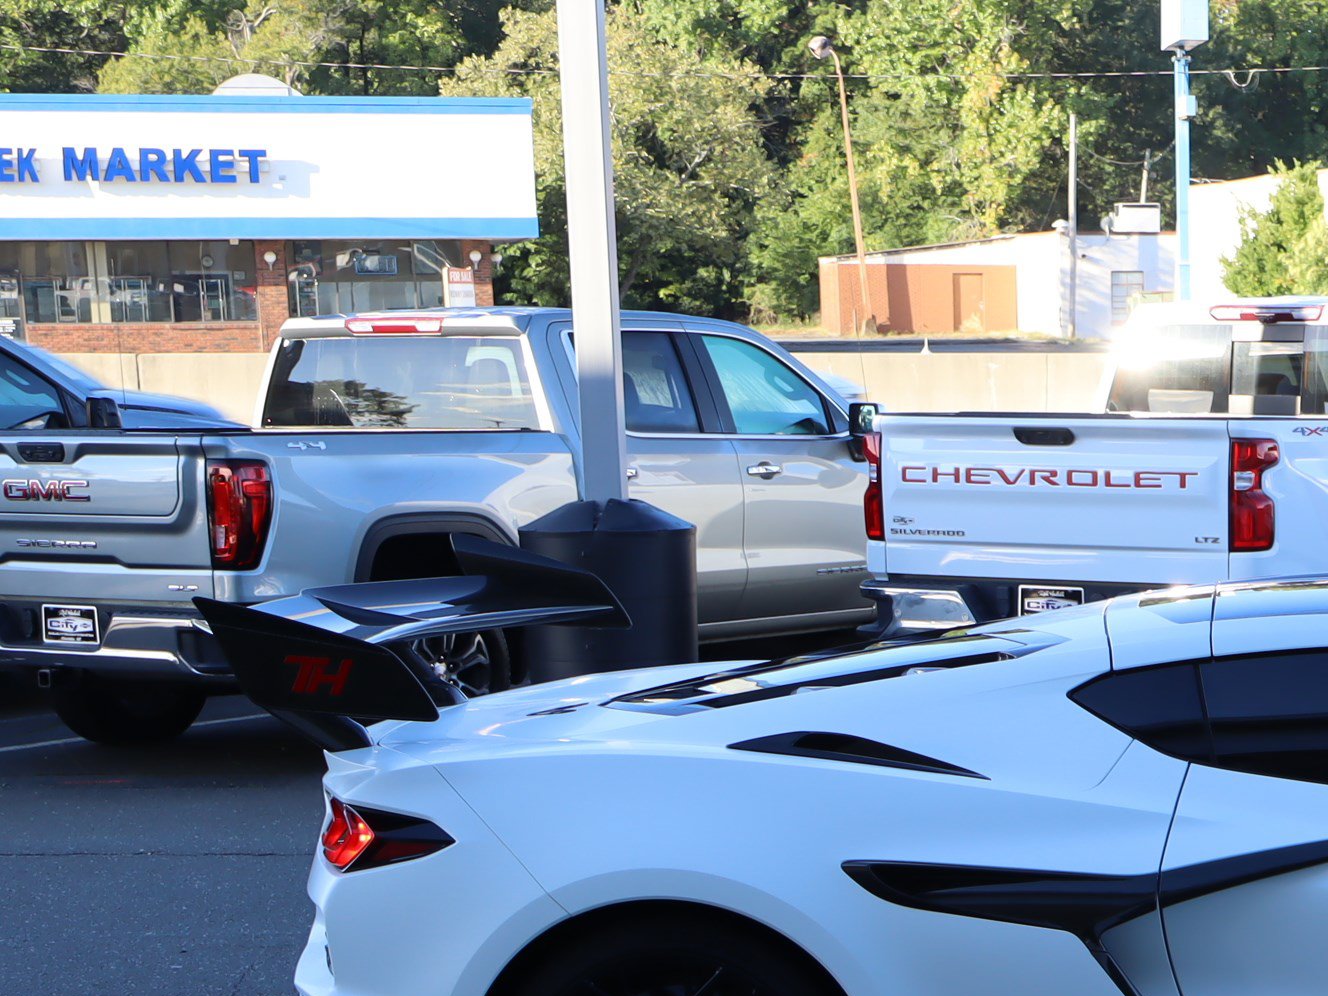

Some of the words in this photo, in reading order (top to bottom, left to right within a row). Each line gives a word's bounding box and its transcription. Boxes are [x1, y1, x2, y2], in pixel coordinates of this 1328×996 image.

[62, 147, 266, 183] MARKET
[901, 466, 1199, 489] CHEVROLET
[2, 479, 91, 501] GMC
[890, 527, 965, 537] SILVERADO
[1194, 536, 1220, 544] LTZ
[16, 538, 97, 549] SIERRA
[283, 655, 354, 696] TH
